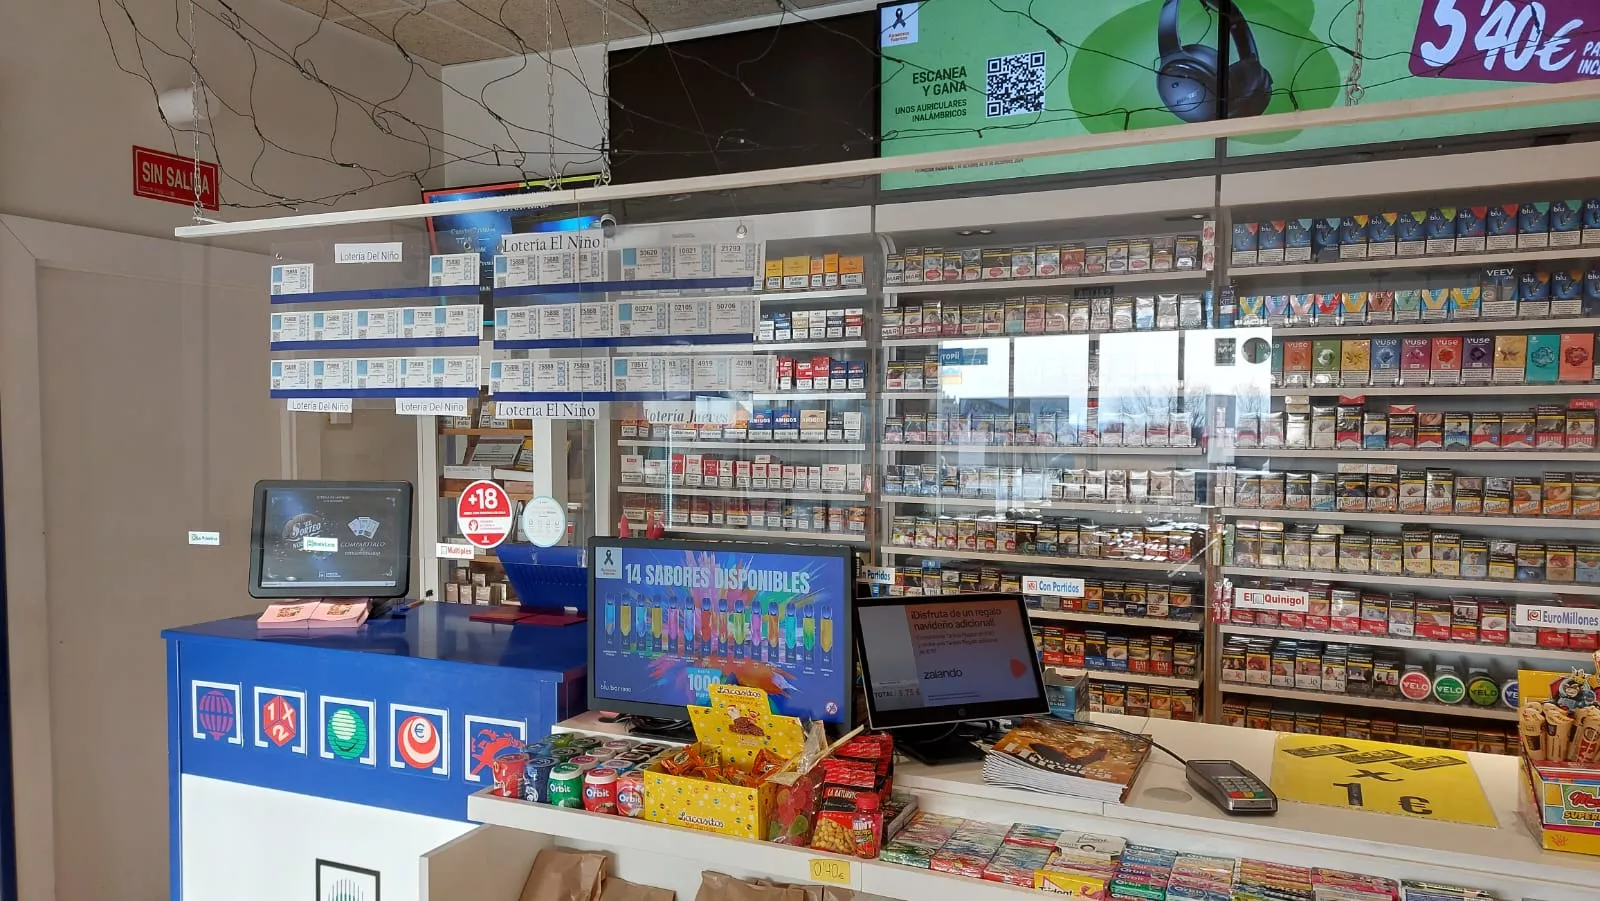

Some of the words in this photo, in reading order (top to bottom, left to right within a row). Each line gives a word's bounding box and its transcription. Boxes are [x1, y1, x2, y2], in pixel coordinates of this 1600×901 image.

[912, 66, 967, 85] ESCANEA
[922, 84, 931, 97] Y
[933, 81, 967, 96] GANA
[895, 106, 915, 116] UNOS
[916, 99, 967, 114] AURICULARES
[912, 107, 967, 122] INALÁMBRICOS
[142, 161, 163, 185] SIN
[1521, 206, 1533, 214] blu
[1553, 204, 1565, 212] blu
[1587, 201, 1599, 209] blu
[1429, 213, 1441, 221] blu
[1460, 211, 1471, 219] blu
[1490, 209, 1502, 217] blu
[1343, 219, 1353, 227] blu
[1371, 217, 1382, 225] blu
[1400, 215, 1411, 223] blu
[1234, 226, 1245, 234] blu
[1261, 224, 1272, 232] blu
[1316, 221, 1327, 229] blu
[503, 238, 546, 253] Lotería
[550, 235, 562, 250] El
[567, 235, 600, 249] Niño
[367, 252, 379, 260] Del
[381, 250, 399, 260] Niño
[1487, 268, 1514, 277] VEEV
[1555, 273, 1567, 281] blu
[1587, 271, 1600, 280] blu
[1522, 275, 1534, 283] blu
[318, 401, 330, 410] Del
[332, 402, 349, 411] Niño
[429, 403, 442, 411] Del
[444, 403, 464, 411] Niño
[498, 402, 543, 417] Lotería
[546, 402, 558, 417] El
[563, 403, 595, 417] Niño
[468, 487, 498, 510] +18
[624, 563, 641, 585] 14
[645, 565, 709, 589] SABORES
[714, 567, 811, 594] DISPONIBLES
[1039, 580, 1051, 592] Con
[1053, 581, 1079, 593] Partidos
[1243, 592, 1253, 601] El
[1264, 594, 1305, 607] Quinigol
[950, 608, 961, 617] de
[975, 606, 1001, 619] regalo
[1542, 610, 1599, 626] EuroMillones
[914, 620, 953, 631] navideño
[923, 668, 963, 680] zalando
[1402, 681, 1429, 691] VELO
[1436, 685, 1463, 694] VELO
[717, 686, 761, 698] Lacasitos
[1471, 689, 1497, 697] VELO
[550, 783, 571, 793] Orbit
[587, 786, 609, 799] Orbit
[618, 793, 642, 804] Orbit
[1333, 782, 1364, 807] 1
[1398, 795, 1433, 815] €
[678, 811, 724, 828] Lacasitos
[1564, 810, 1600, 821] SUPER
